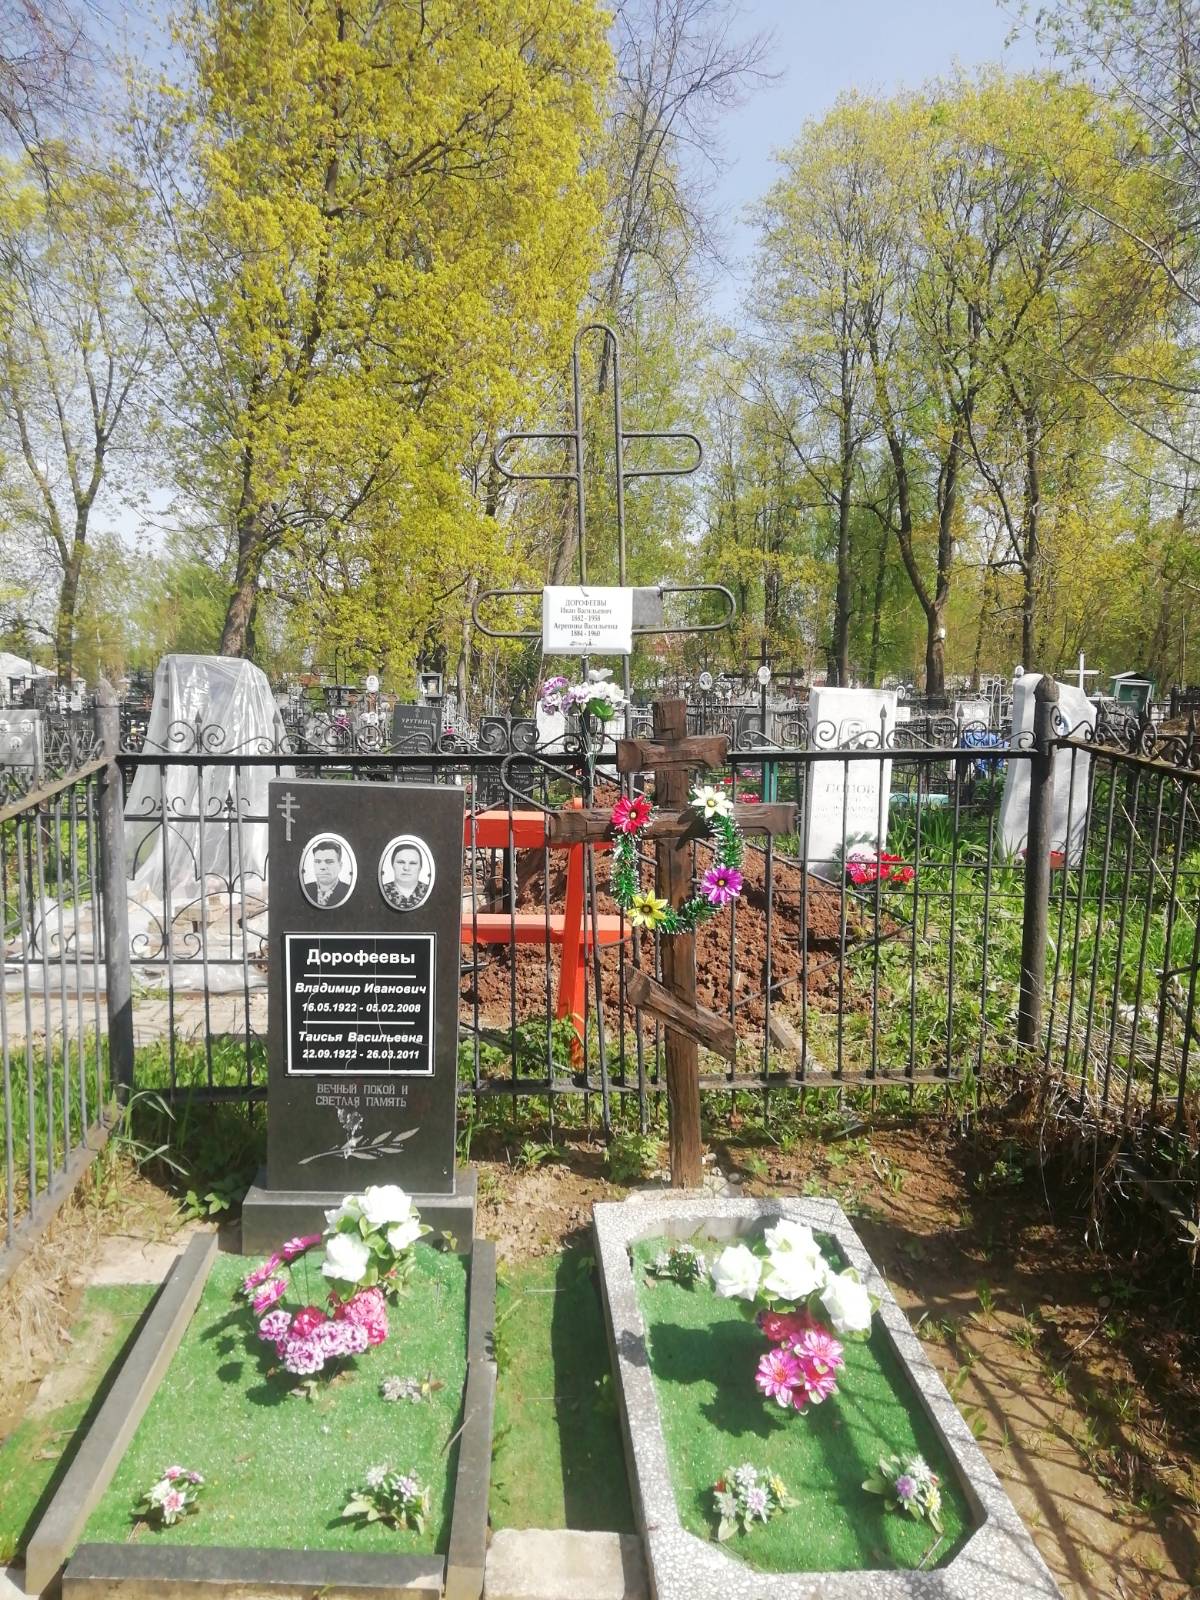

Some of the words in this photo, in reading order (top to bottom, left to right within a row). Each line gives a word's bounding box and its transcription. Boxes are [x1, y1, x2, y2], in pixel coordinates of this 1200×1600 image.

[306, 949, 416, 967] Дорофеевы
[295, 982, 361, 996] Владимир
[364, 983, 427, 995] Иванович
[302, 1002, 357, 1013] 16.05.1922
[366, 1003, 421, 1013] 05.02.2008
[298, 1031, 343, 1043] Таисья
[348, 1032, 423, 1043] Васильевна
[302, 1049, 357, 1059] 22.09.1922
[366, 1049, 420, 1059] 26.03.2011
[317, 1083, 357, 1094] ВЕЧНЫЙ
[363, 1083, 395, 1095] ПОКОЙ
[401, 1084, 408, 1095] И
[315, 1096, 360, 1106] СВЕТЛАЯ
[365, 1096, 407, 1107] ПАМЯТЬ
